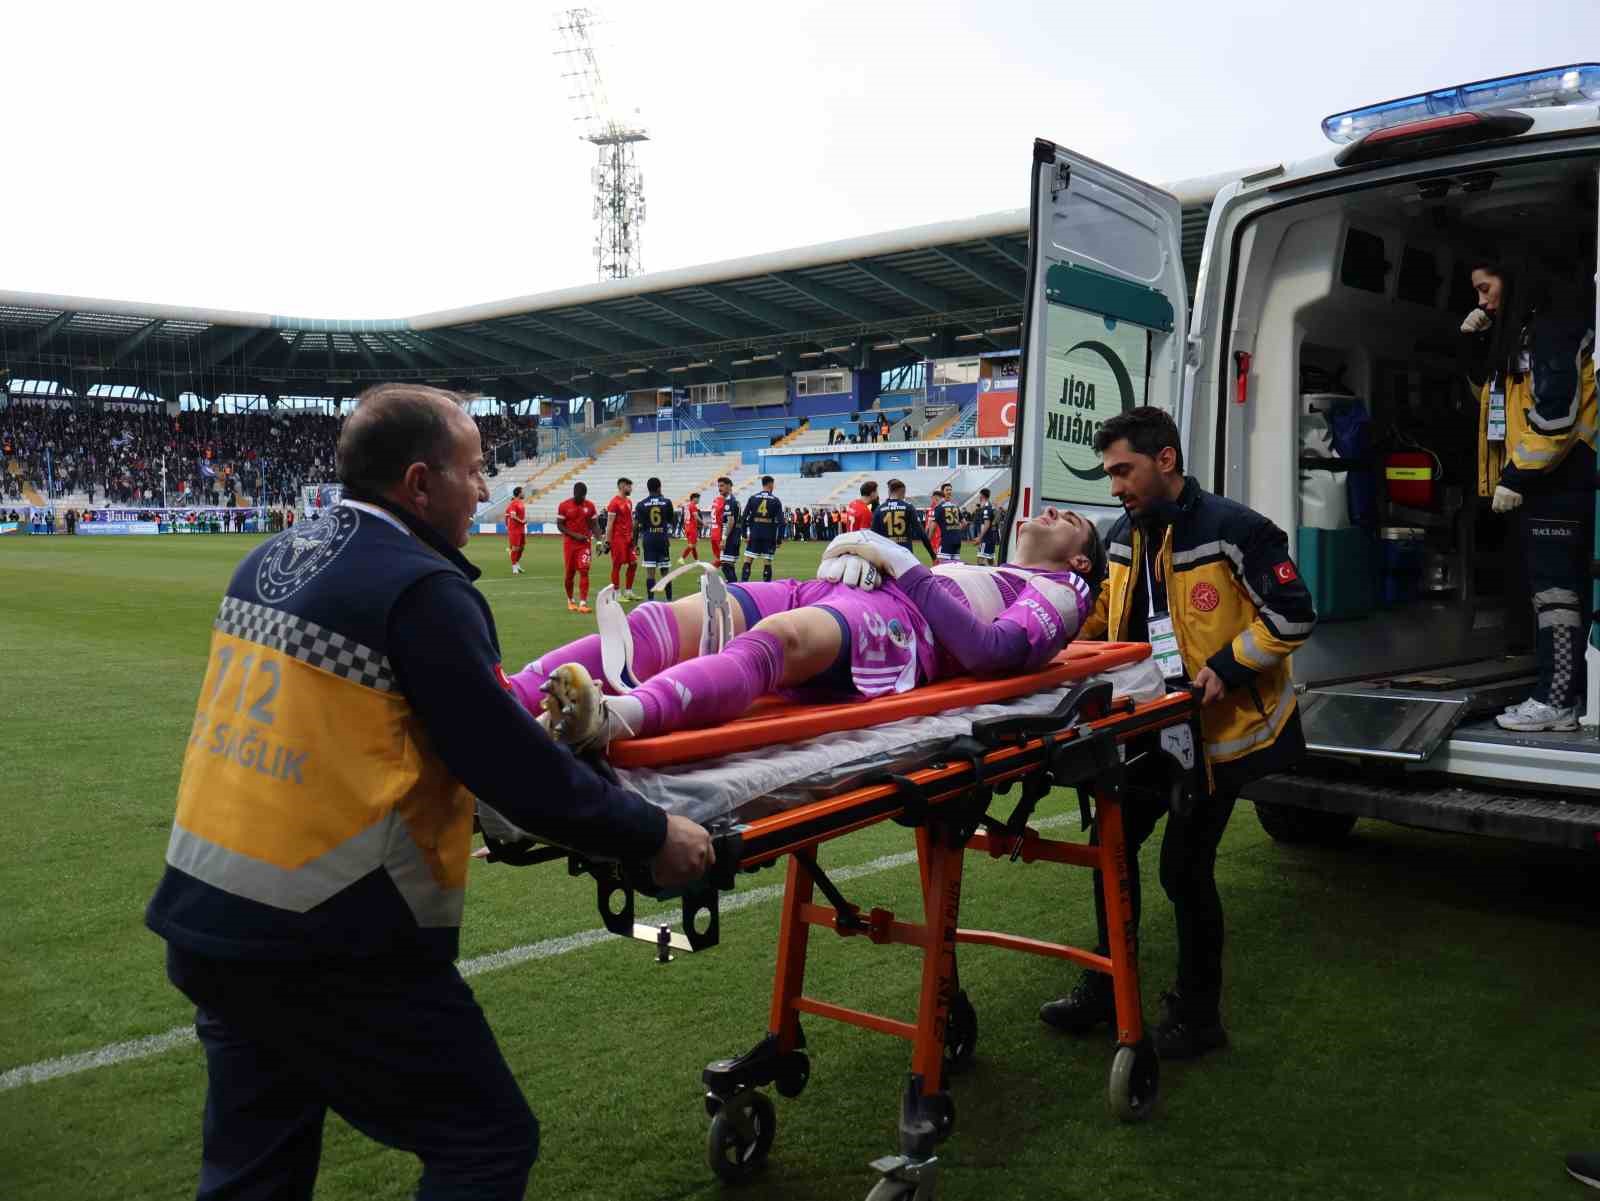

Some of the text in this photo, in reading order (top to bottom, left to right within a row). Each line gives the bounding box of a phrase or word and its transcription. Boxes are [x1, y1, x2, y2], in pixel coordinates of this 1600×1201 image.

[649, 505, 662, 527] 6
[757, 498, 769, 517] 4
[883, 510, 906, 537] 15
[213, 646, 282, 726] 112
[209, 723, 313, 785] SAĞLIK
